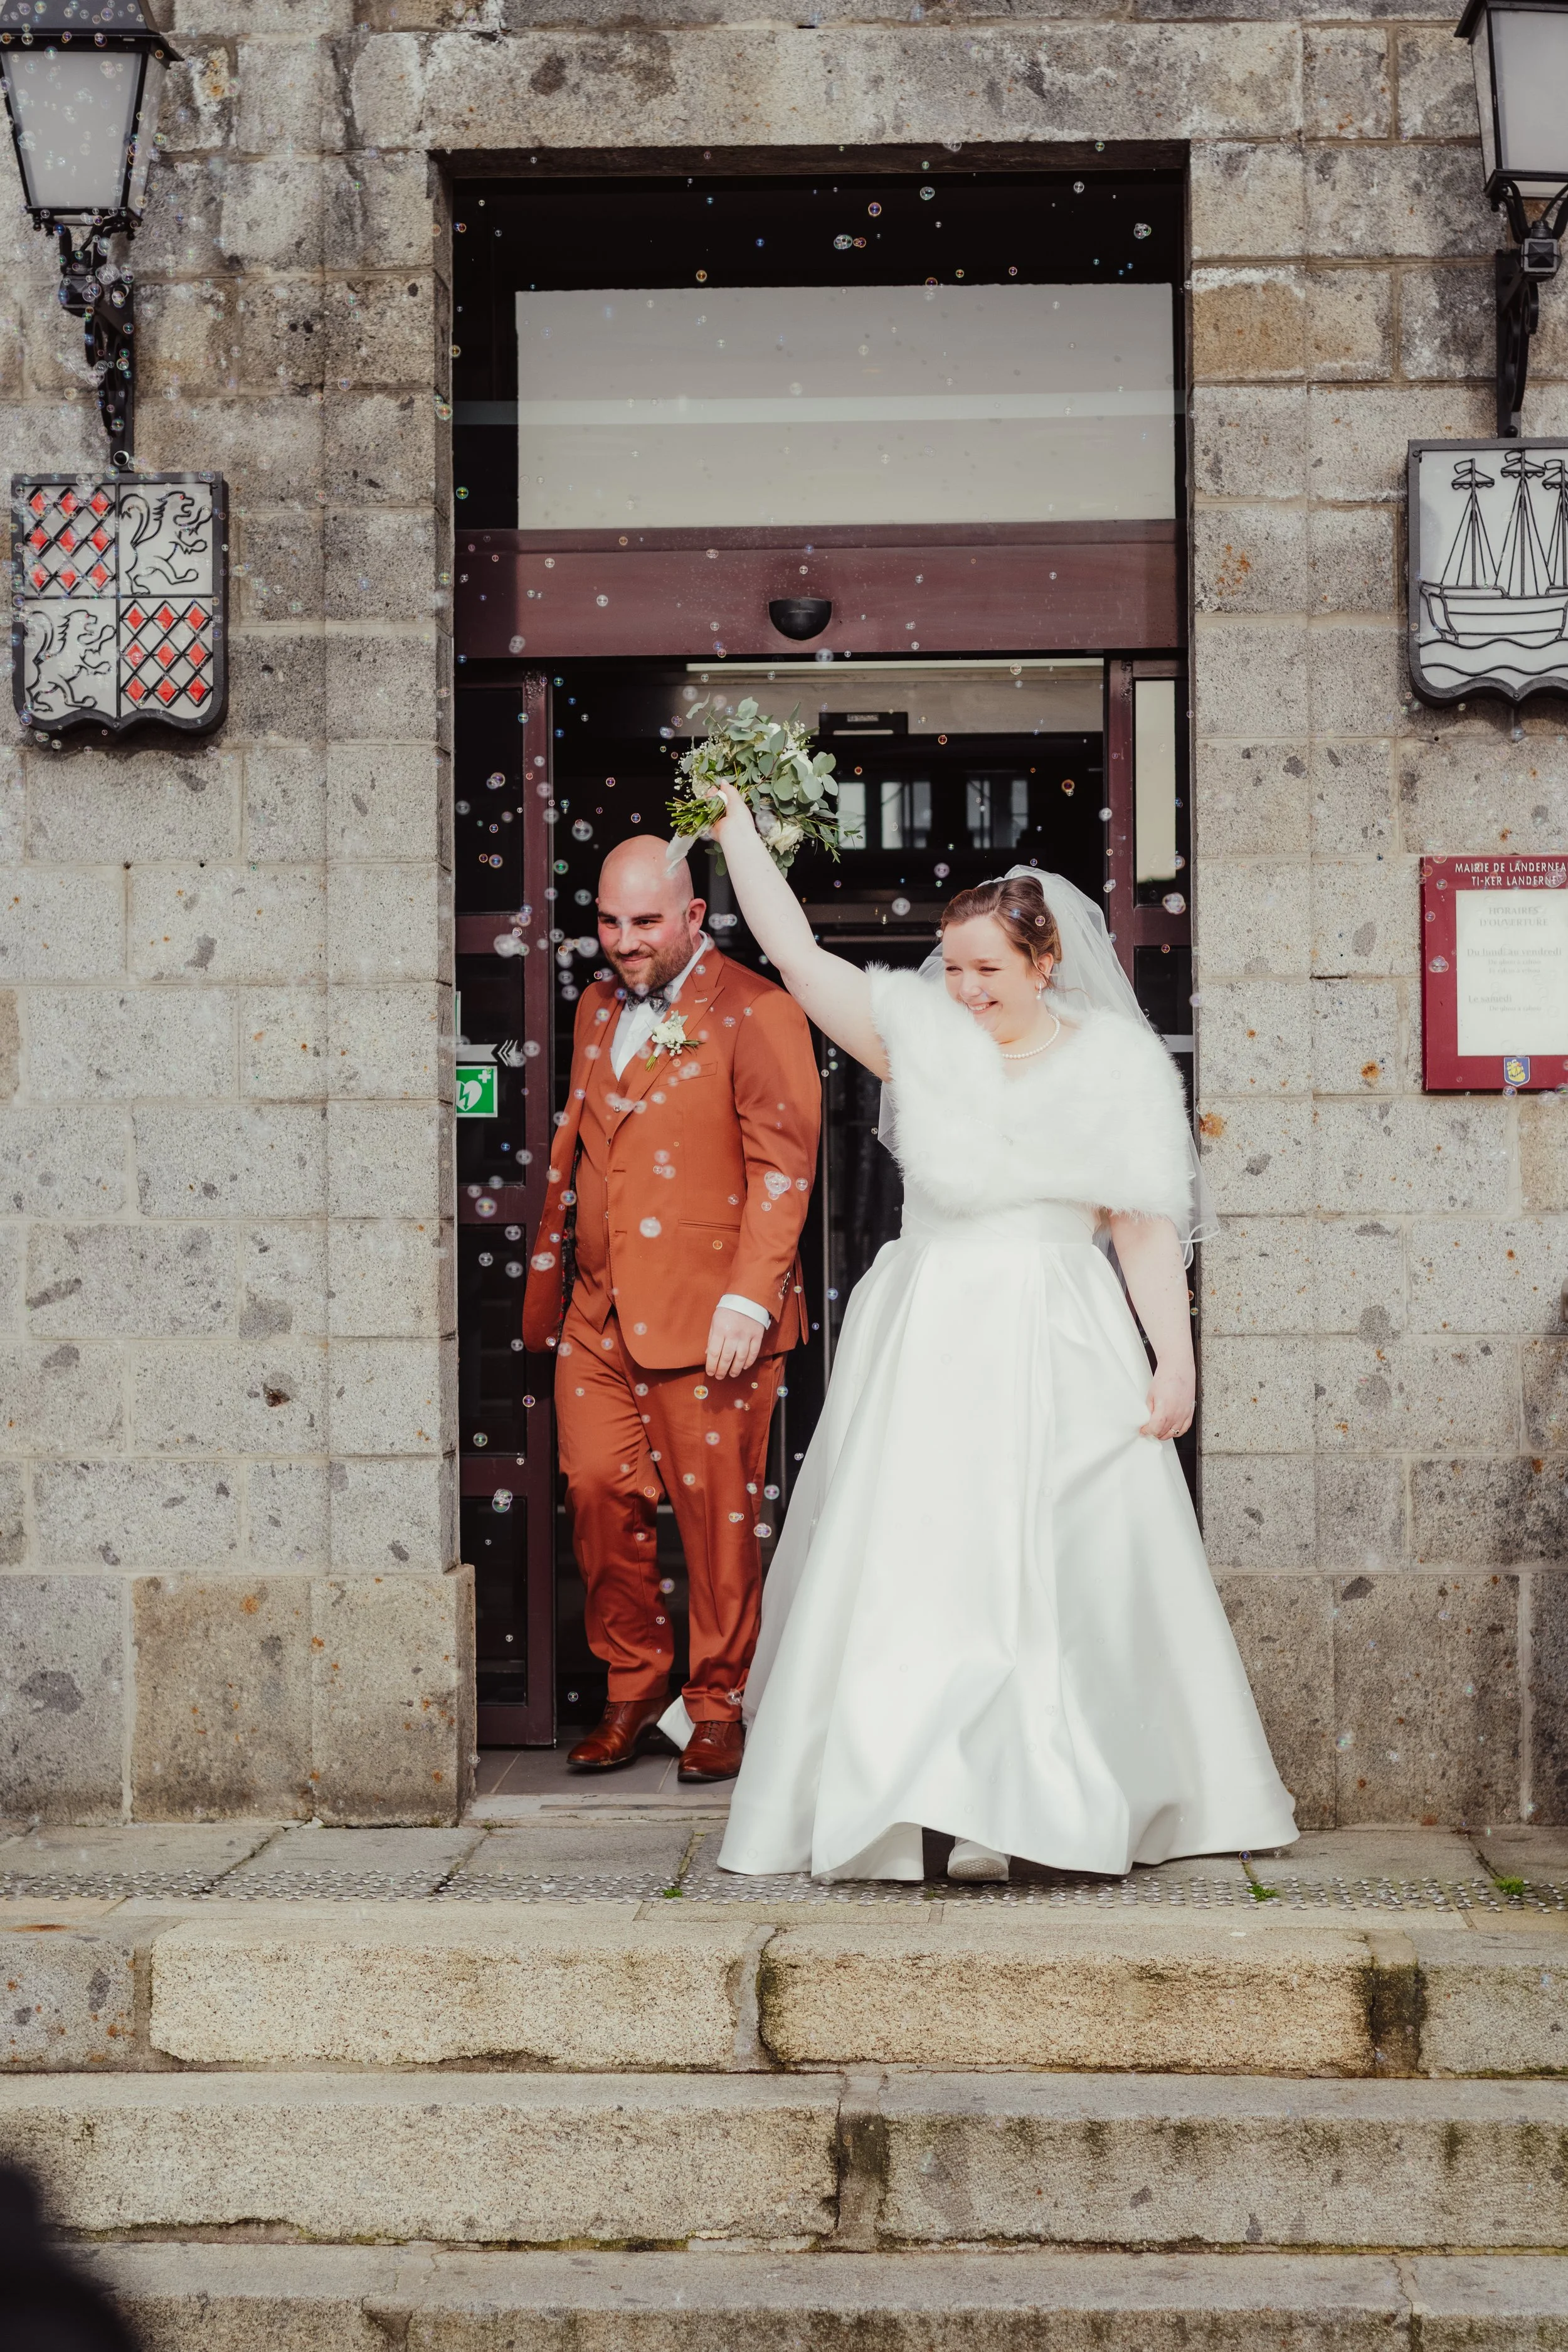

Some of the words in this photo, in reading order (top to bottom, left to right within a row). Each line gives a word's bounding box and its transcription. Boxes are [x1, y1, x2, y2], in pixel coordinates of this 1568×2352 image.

[1455, 862, 1489, 872] MAIRIE
[1493, 862, 1505, 872] DE
[1510, 862, 1568, 872] LANDERNEA
[1488, 906, 1539, 914] HORAIRES
[1479, 918, 1549, 926] D'OUVERTURE
[1521, 947, 1562, 956] vendredi
[1468, 995, 1478, 1004] Le
[1480, 994, 1512, 1003] samedi
